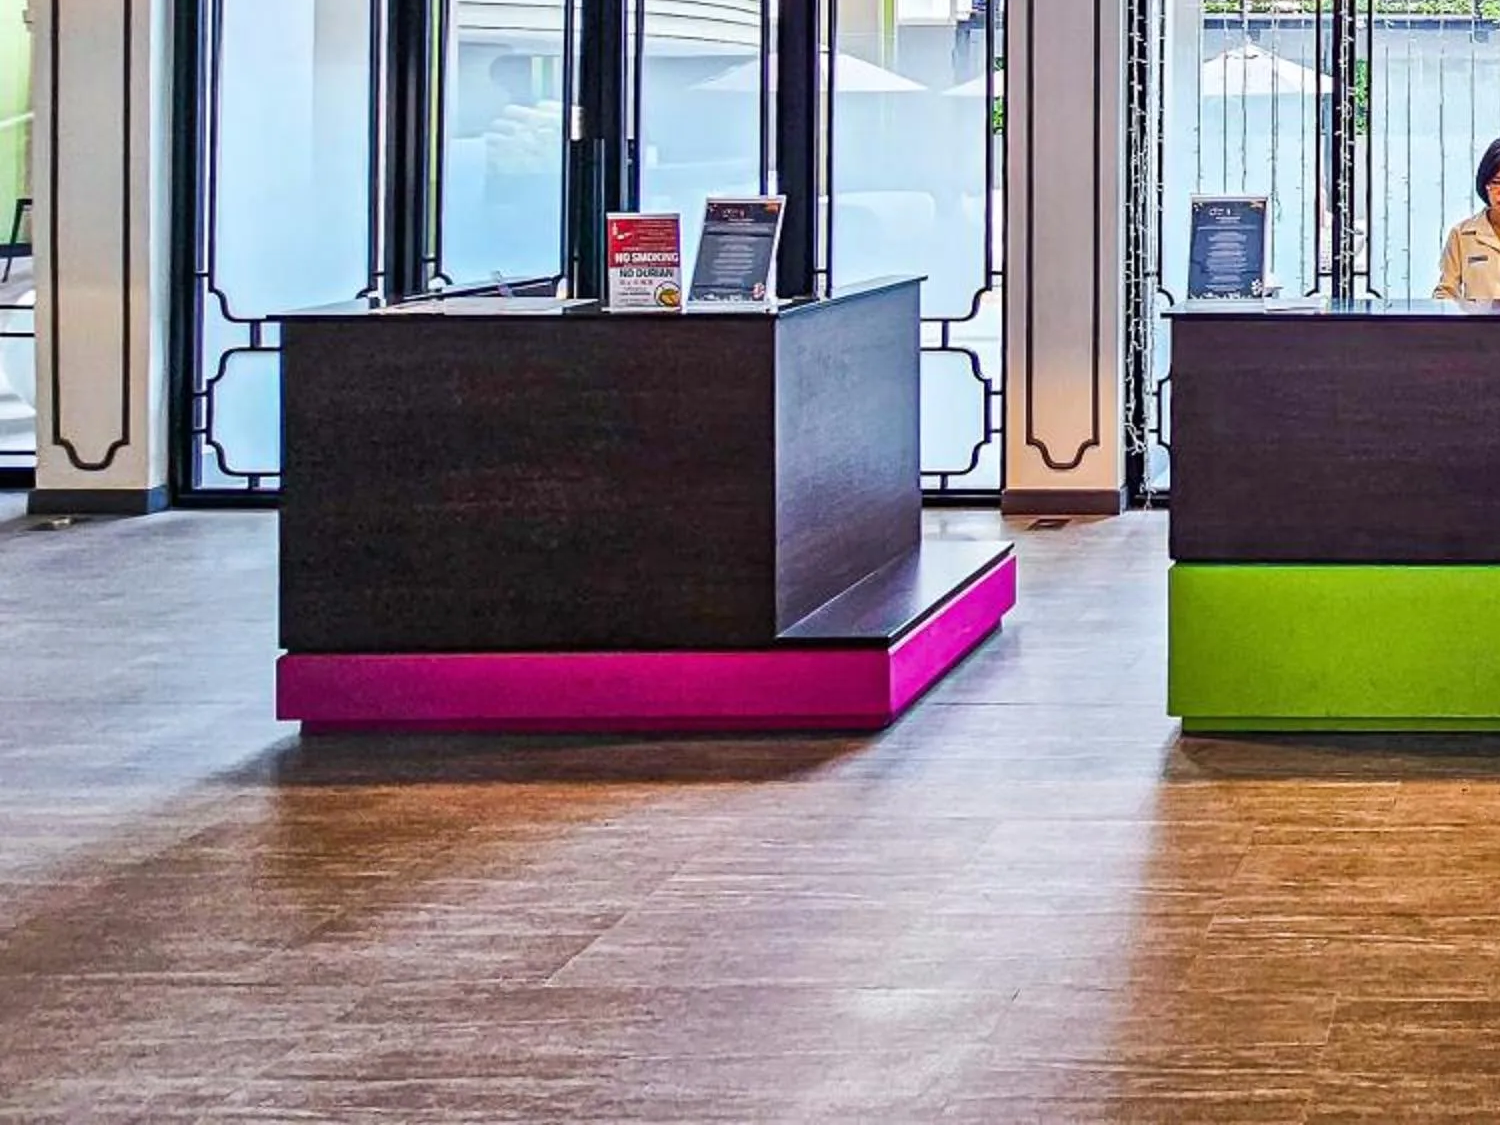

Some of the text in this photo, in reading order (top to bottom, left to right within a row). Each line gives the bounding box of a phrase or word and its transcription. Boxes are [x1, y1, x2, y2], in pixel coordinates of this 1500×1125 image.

[615, 252, 679, 264] NO SMOKING
[620, 268, 673, 277] NO DURIAN
